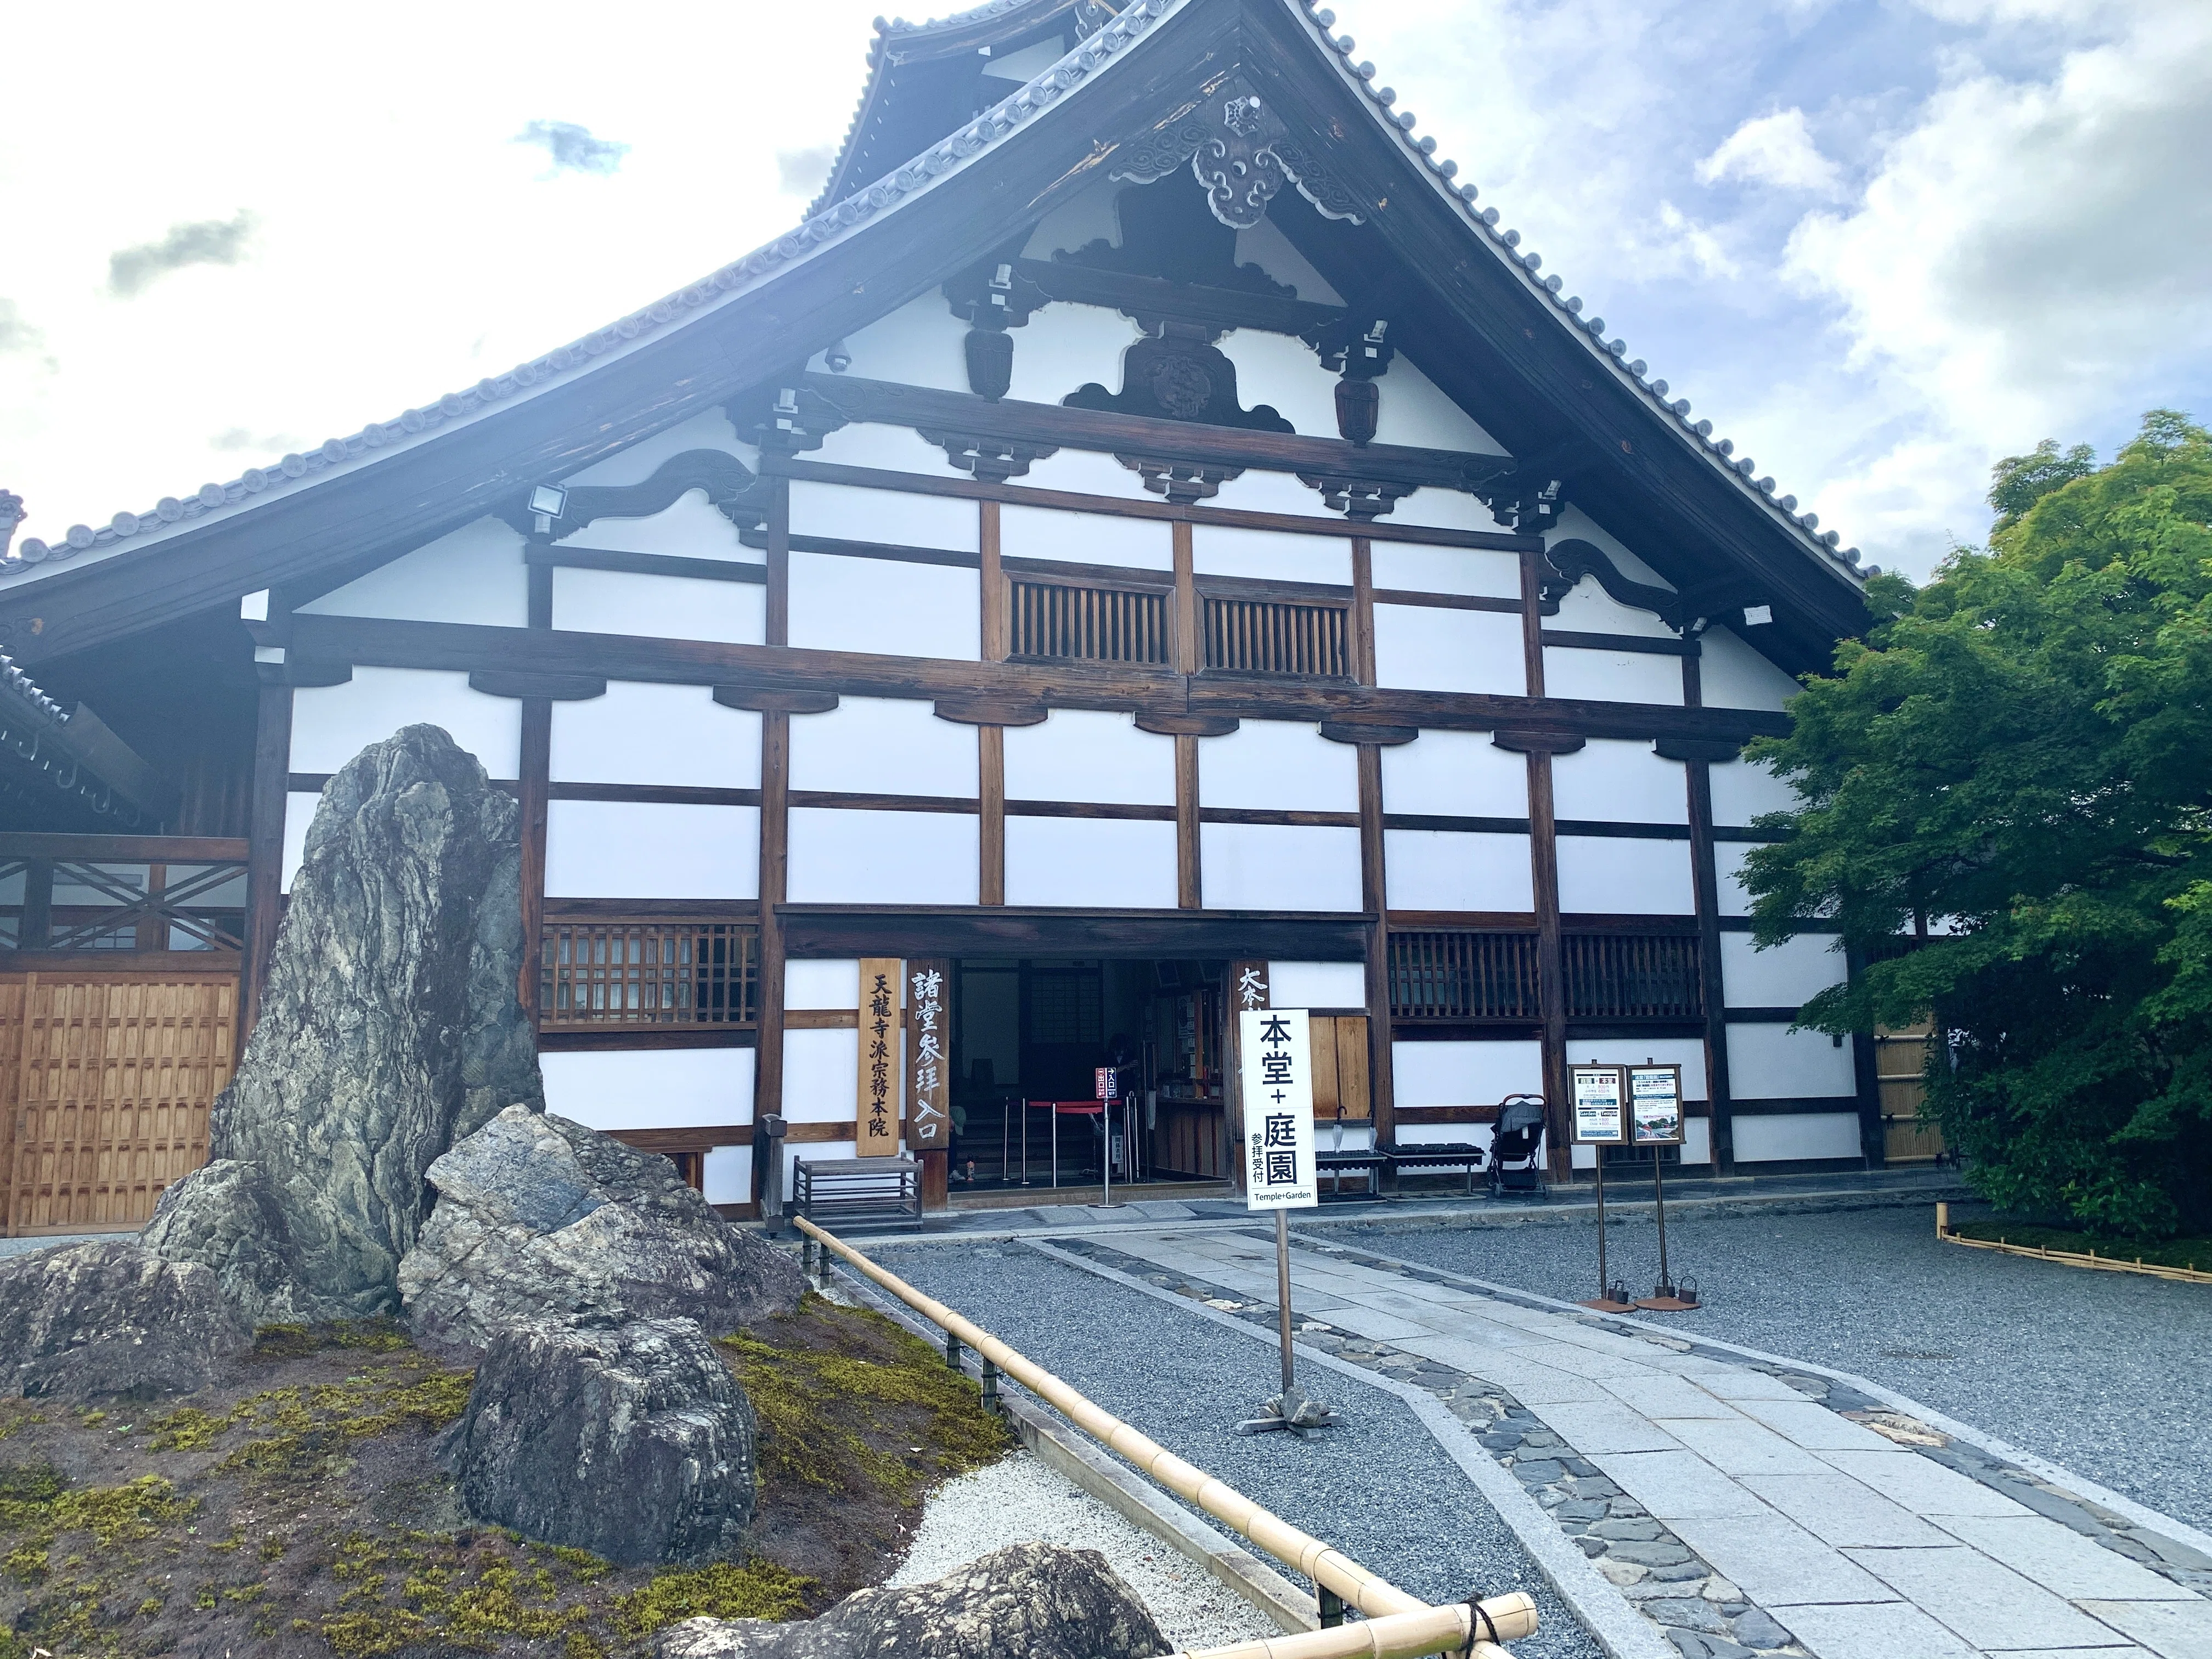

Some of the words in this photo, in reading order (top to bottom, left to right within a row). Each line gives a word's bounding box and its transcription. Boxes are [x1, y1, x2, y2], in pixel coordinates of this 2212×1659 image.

[1238, 968, 1268, 1011] 大本
[868, 974, 893, 1138] 天龍寺派宗務本院
[1098, 1075, 1104, 1088] 出口
[1108, 1075, 1115, 1088] 入口
[1251, 1133, 1263, 1183] 参拝受付
[1254, 1191, 1311, 1202] Temple+Garden
